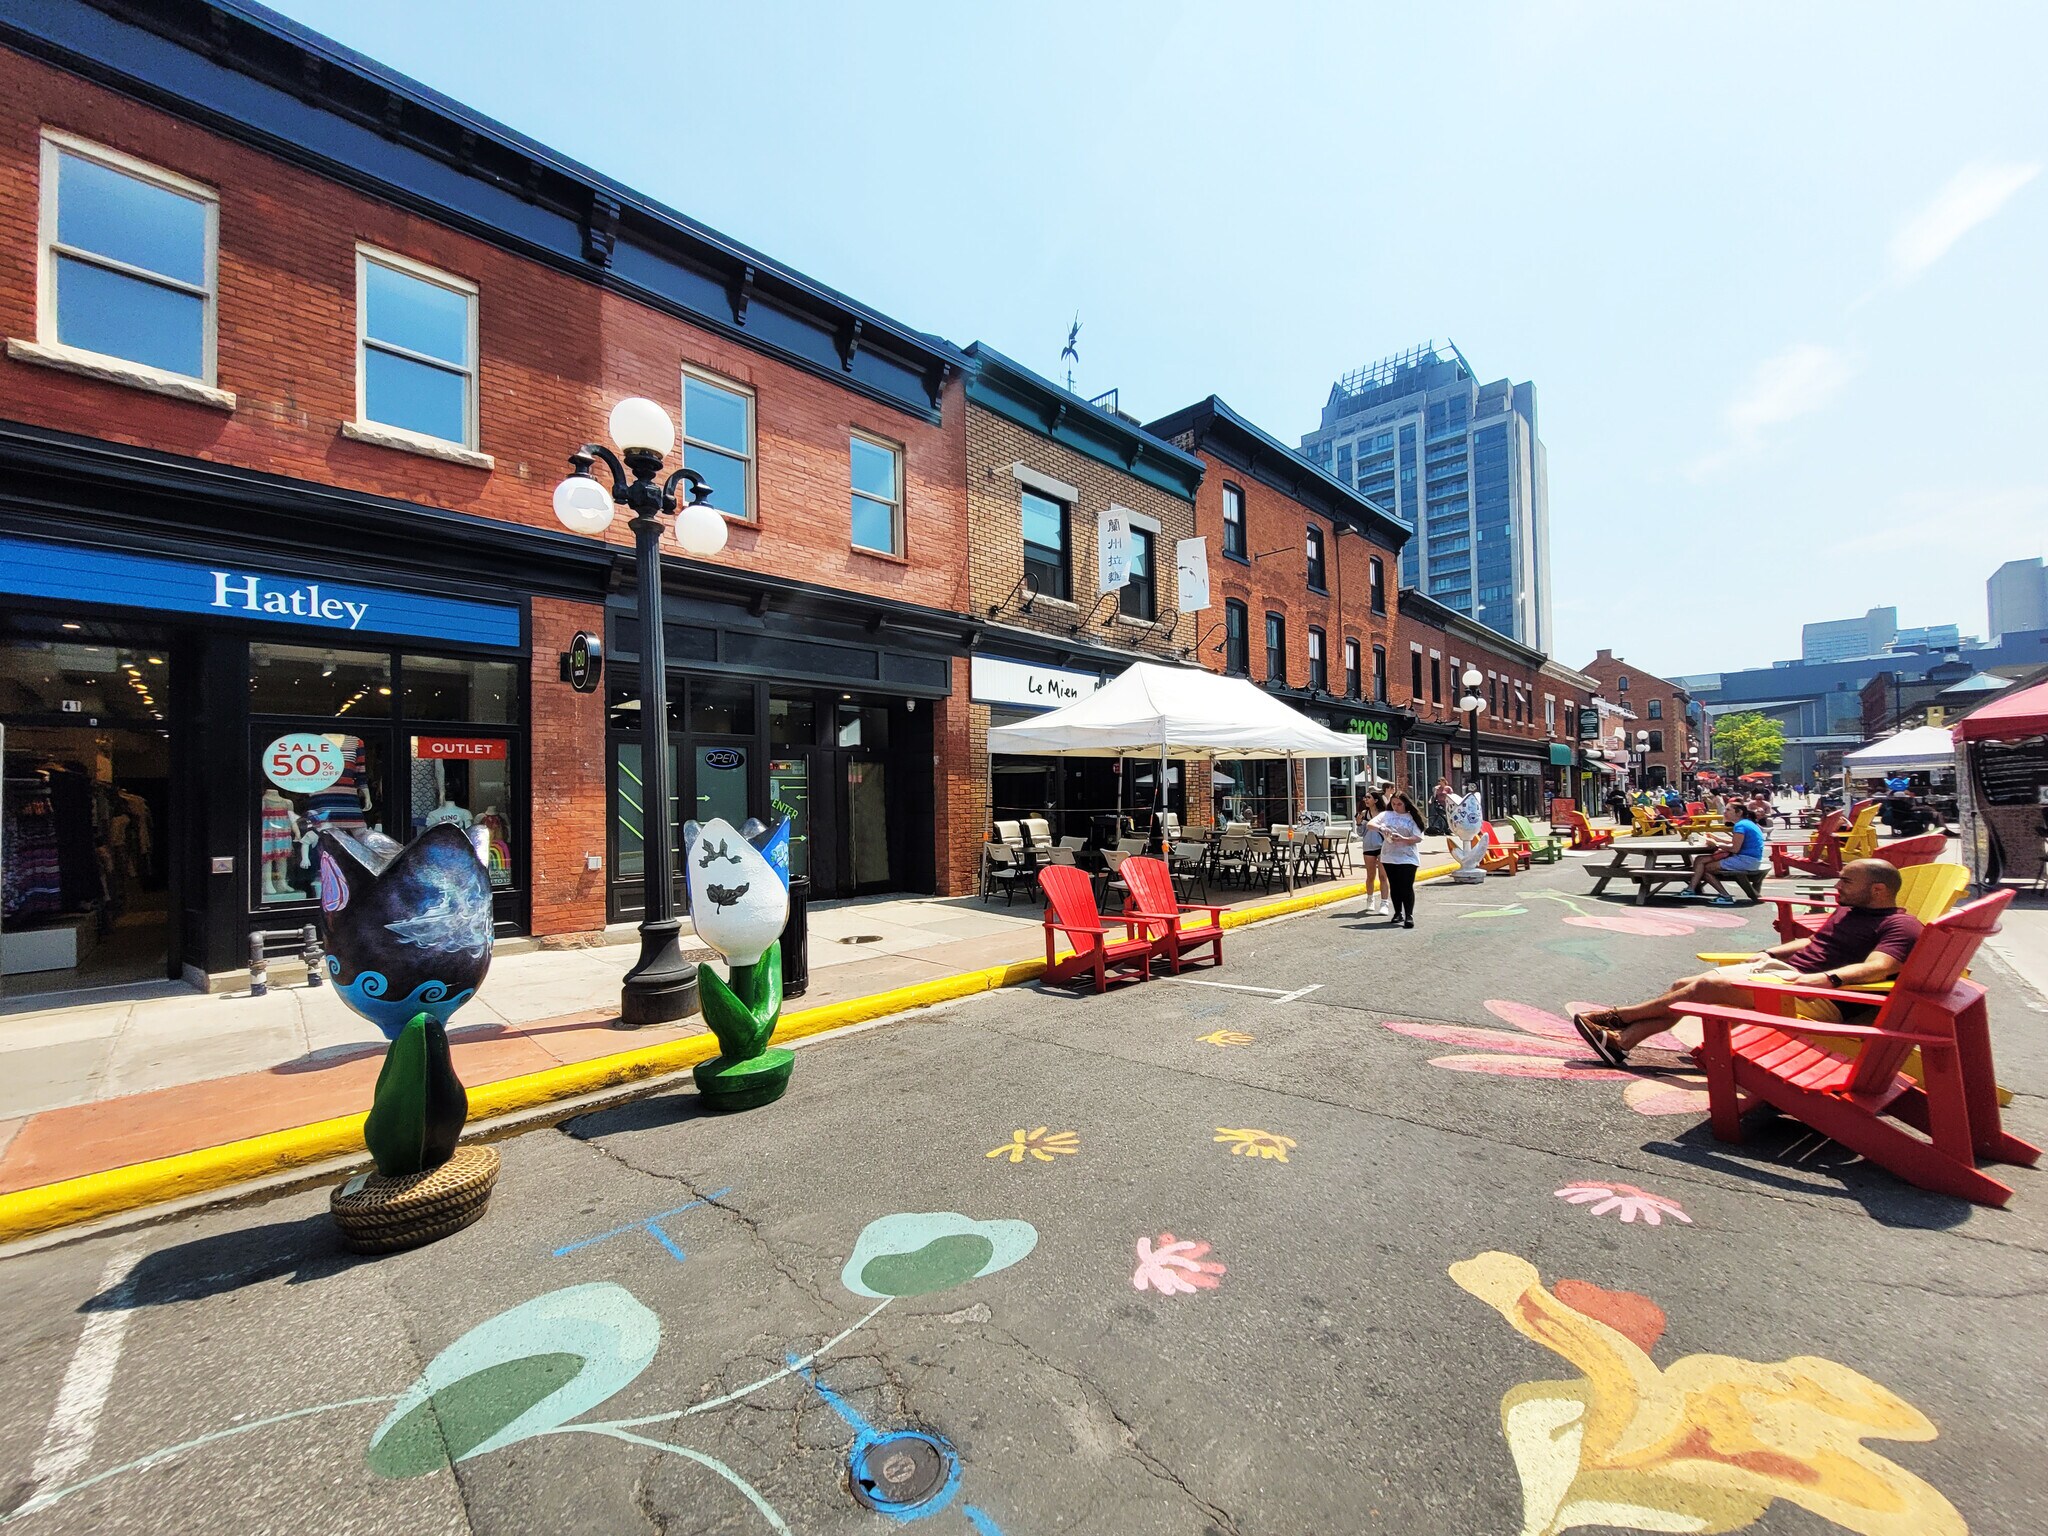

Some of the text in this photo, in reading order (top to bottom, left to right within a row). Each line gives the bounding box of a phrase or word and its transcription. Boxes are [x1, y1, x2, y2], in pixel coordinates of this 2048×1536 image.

[209, 571, 369, 630] Hatley
[1028, 675, 1043, 695] Le
[1048, 679, 1078, 699] Mien
[64, 701, 79, 711] 41
[1347, 718, 1389, 741] crocs
[278, 743, 330, 752] SALE
[431, 743, 493, 754] OUTLET
[705, 752, 739, 764] OPEN
[771, 799, 799, 820] ENTER
